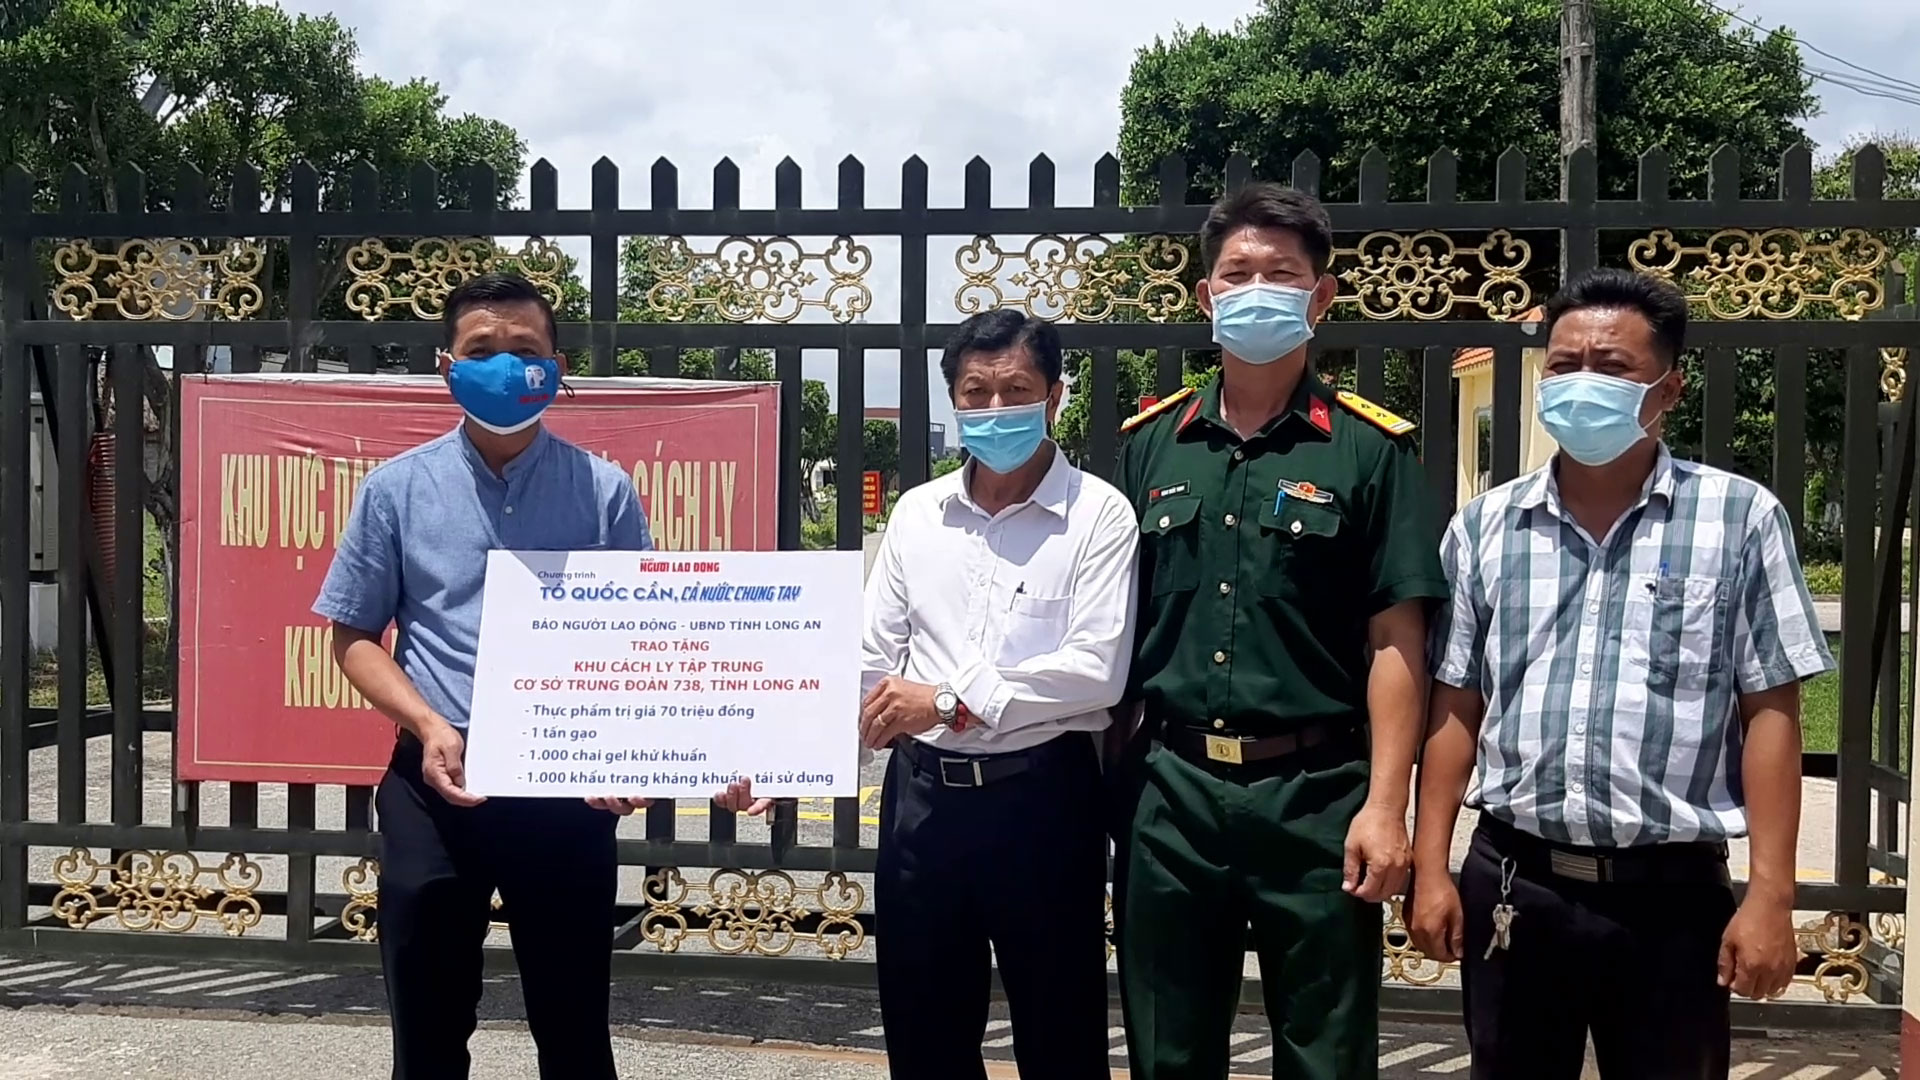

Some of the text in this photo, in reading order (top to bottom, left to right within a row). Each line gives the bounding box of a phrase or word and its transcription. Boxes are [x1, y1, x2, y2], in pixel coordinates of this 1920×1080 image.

[221, 453, 270, 547] KHU
[277, 448, 326, 571] VỰC
[709, 461, 737, 551] LY
[671, 561, 691, 573] LAO
[571, 580, 628, 601] QUỐC
[734, 584, 777, 602] CHUNG
[776, 584, 802, 602] TAY
[532, 617, 558, 630] BÁO
[563, 618, 606, 630] NGƯỜI
[611, 621, 635, 630] LAO
[640, 618, 677, 632] ĐỘNG
[690, 621, 725, 630] UBND
[765, 620, 799, 630] LONG
[803, 620, 821, 630] AN
[630, 638, 709, 654] TRAO TẶNG
[574, 658, 763, 675] KHU CÁCH LY TẬP TRUNG
[514, 679, 537, 690] CƠ
[567, 679, 620, 691] TRUNG
[674, 680, 704, 693] 738,
[753, 679, 794, 690] LONG
[799, 679, 819, 690] AN
[533, 704, 567, 719] Thực
[615, 705, 631, 720] trị
[634, 705, 656, 720] giá
[661, 706, 677, 717] 70
[681, 705, 714, 719] triệu
[532, 727, 537, 738] 1
[570, 730, 597, 742] gạo
[530, 749, 568, 760] 1.000
[572, 749, 601, 761] chai
[605, 749, 627, 764] gel
[528, 772, 566, 783] 1.000
[610, 773, 648, 787] trang
[653, 772, 698, 787] kháng
[755, 772, 773, 783] tái
[796, 771, 833, 786] dụng
